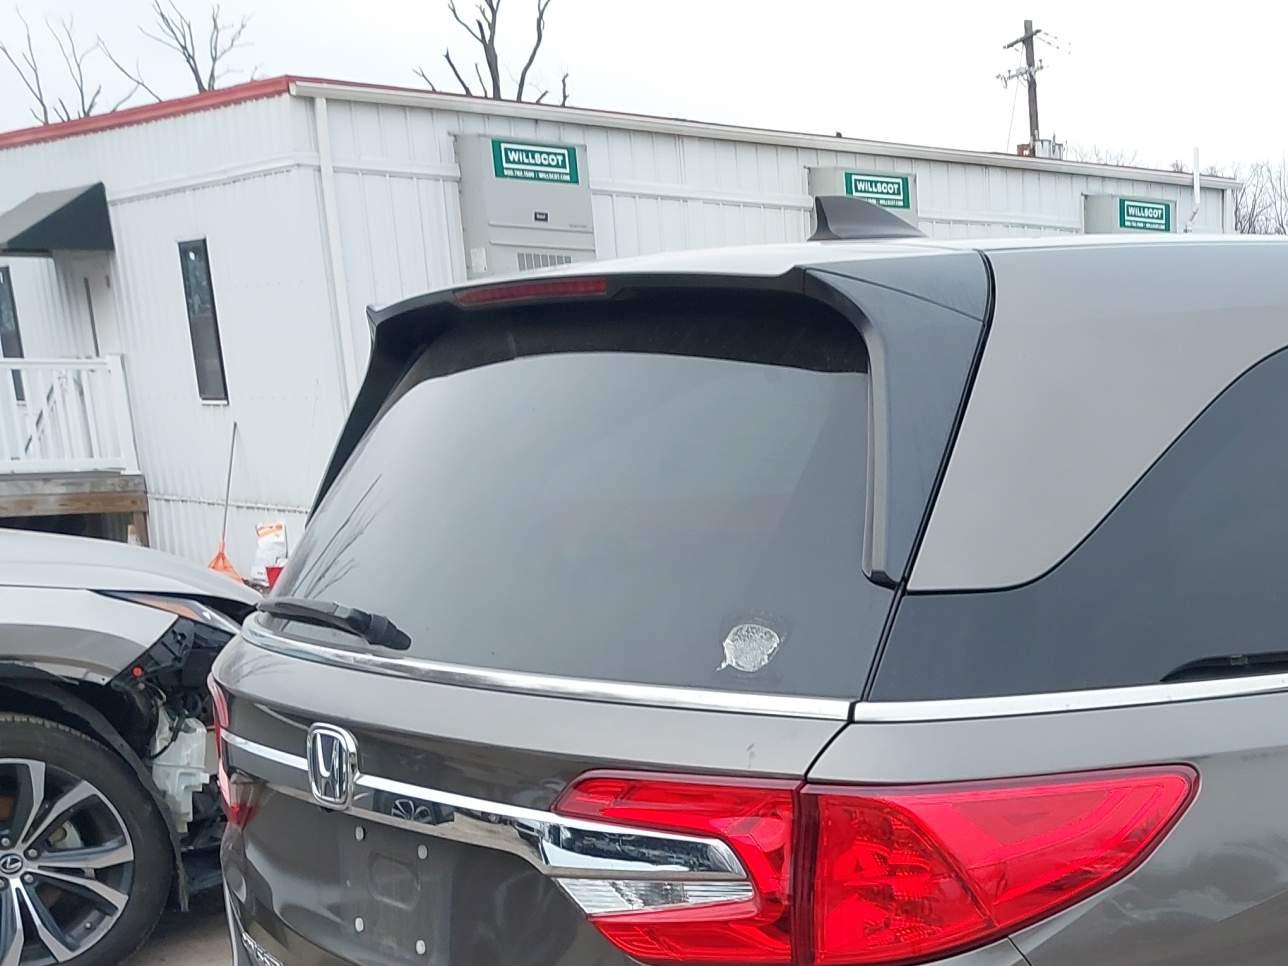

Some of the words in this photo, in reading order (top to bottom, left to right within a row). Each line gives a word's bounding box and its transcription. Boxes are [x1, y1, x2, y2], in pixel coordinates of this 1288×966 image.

[507, 149, 564, 166] WILLSCOT
[857, 180, 899, 194] WILLSCOT
[1128, 206, 1162, 218] WILLSCOT
